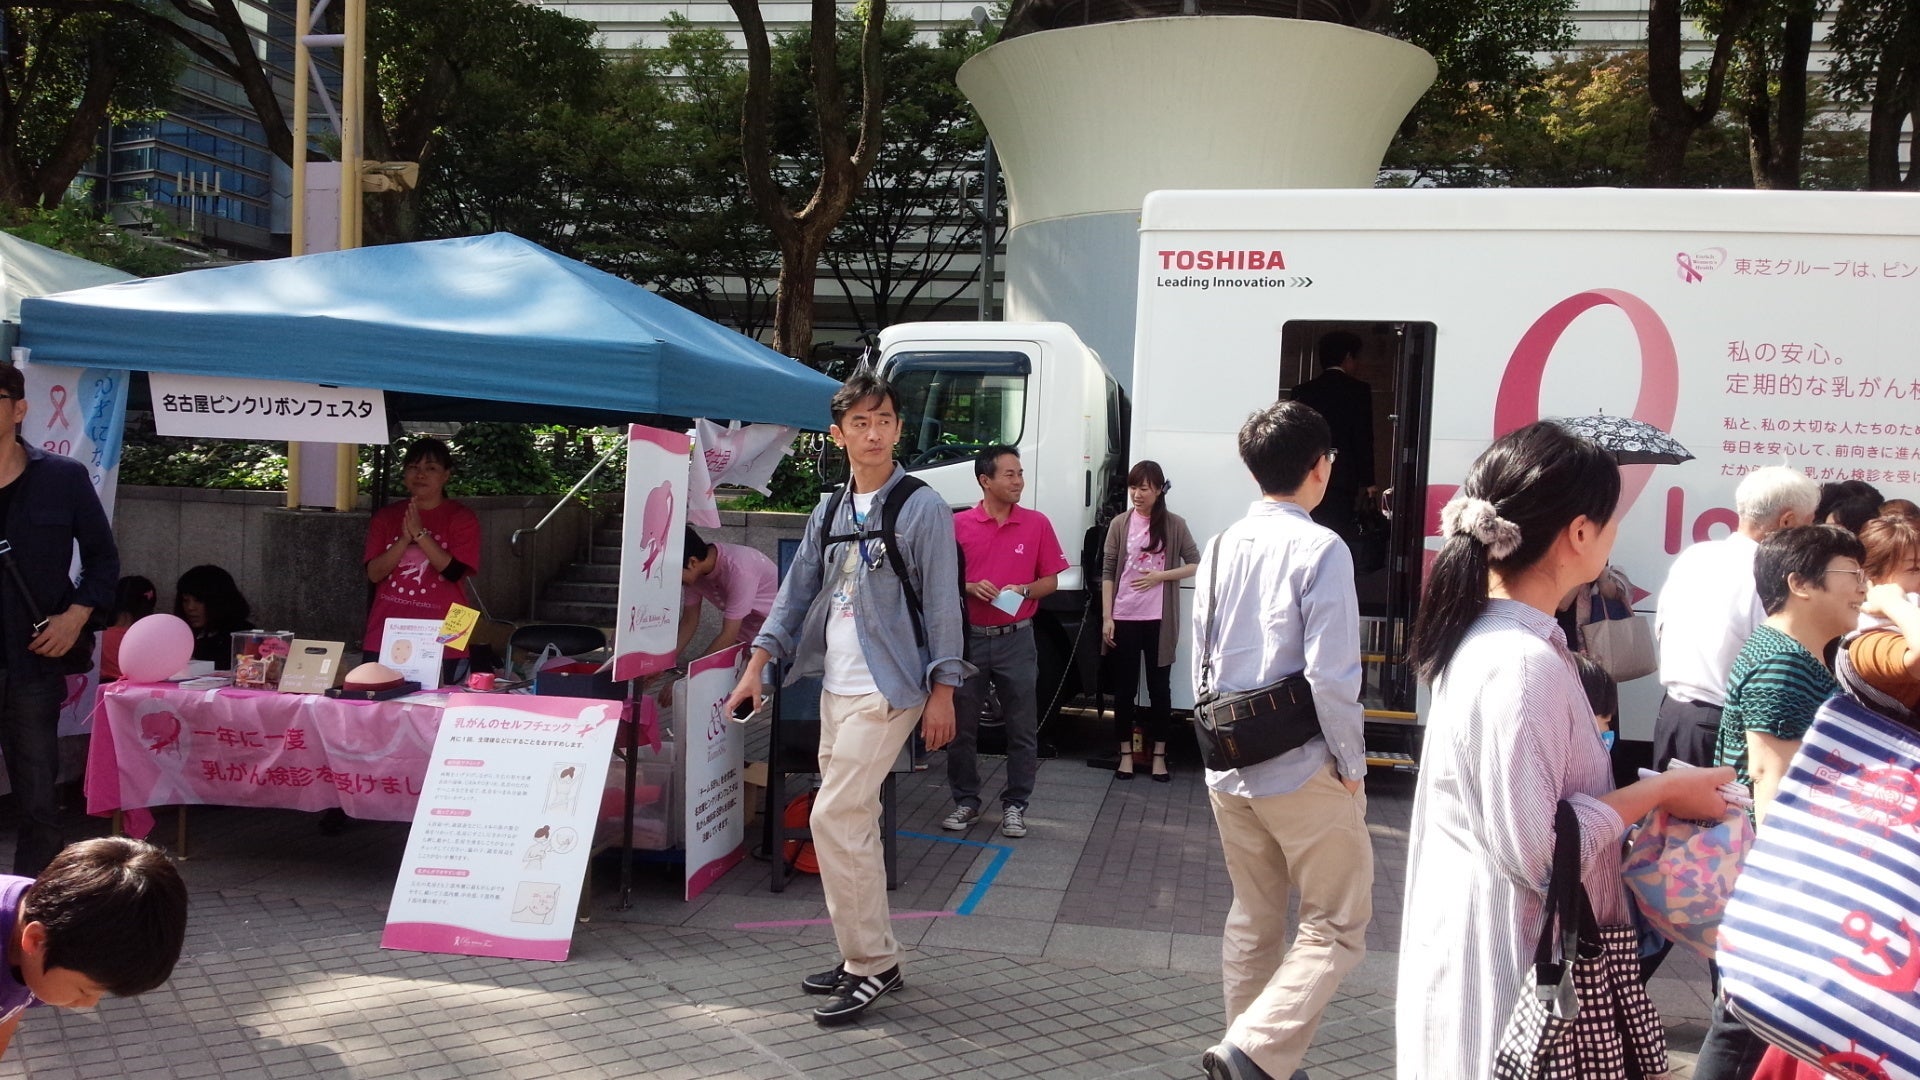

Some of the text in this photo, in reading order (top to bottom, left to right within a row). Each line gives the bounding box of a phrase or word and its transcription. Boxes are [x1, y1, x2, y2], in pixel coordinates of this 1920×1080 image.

[1158, 250, 1286, 270] TOSHIBA
[1734, 258, 1919, 278] 東芝グループは、ピン
[1157, 276, 1286, 290] Leading Innovation
[1727, 340, 1844, 365] 私の安心。
[163, 394, 373, 418] 名古屋ピンクリボンフェスタ
[454, 717, 572, 733] 乳がんのセルフチェック
[194, 726, 307, 750] 一年に一度
